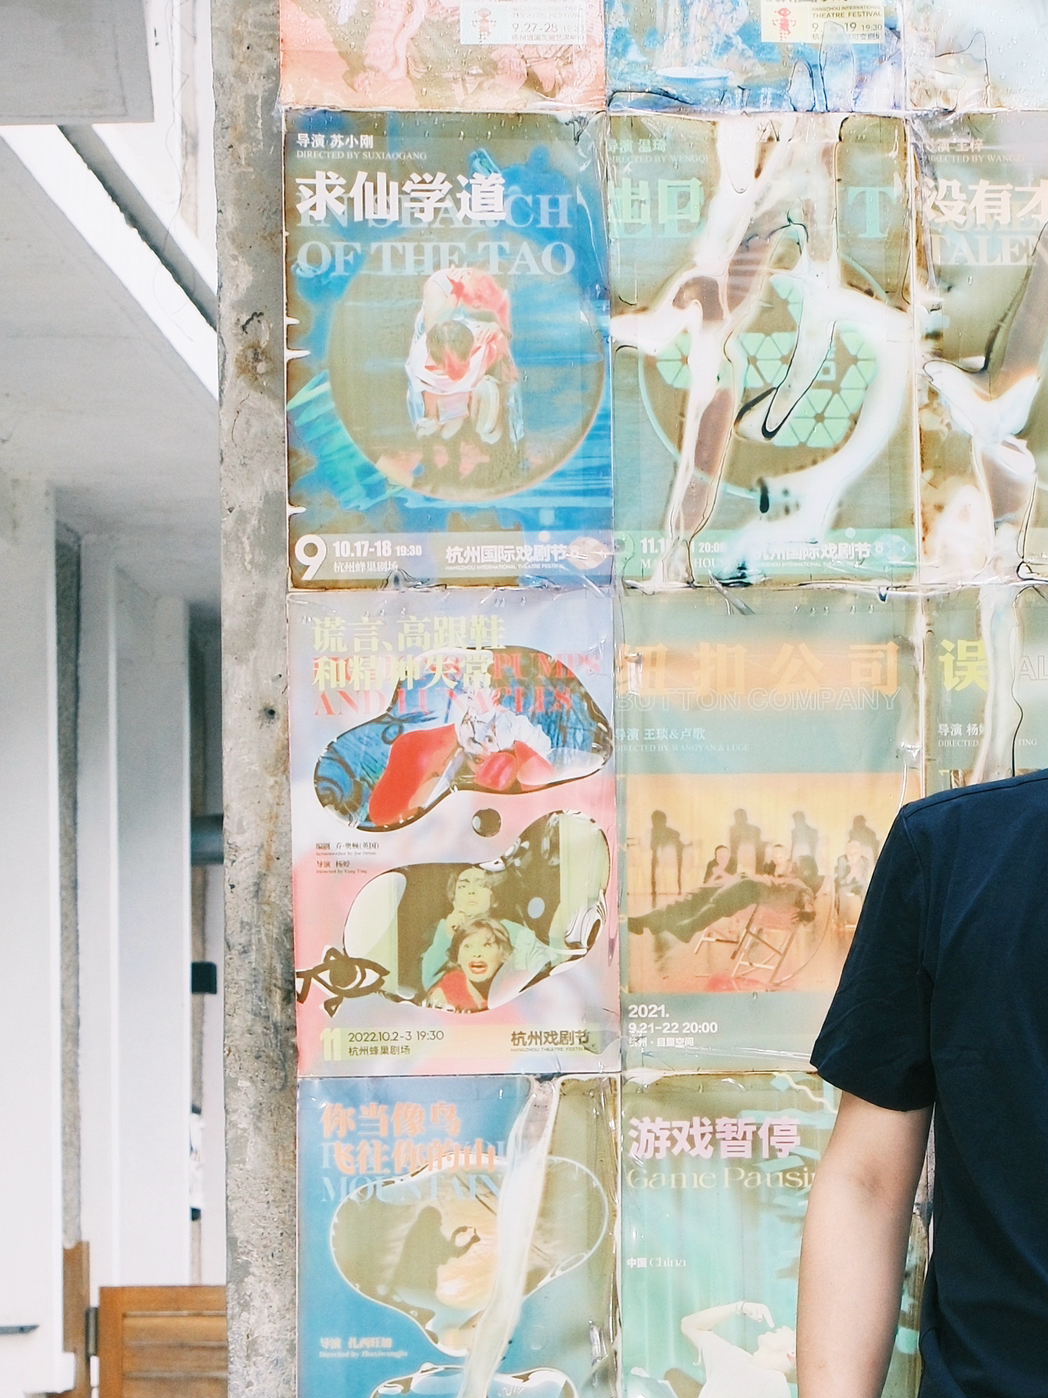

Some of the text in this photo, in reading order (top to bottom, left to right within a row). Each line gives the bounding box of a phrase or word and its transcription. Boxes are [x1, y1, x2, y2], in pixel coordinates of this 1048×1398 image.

[296, 133, 374, 149] 导演 苏小刚
[296, 151, 345, 160] DIRECTED
[346, 151, 360, 160] BY
[295, 170, 507, 222] 求仙学道
[297, 241, 362, 276] OF
[478, 241, 576, 276] TAO
[295, 534, 327, 580] 9
[333, 540, 422, 557] 10.17-18 19:30
[445, 544, 567, 563] 杭州国际戏剧节
[312, 615, 506, 651] 谎言、高跟鞋
[312, 654, 494, 691] 和精神失常
[748, 687, 902, 710] COMPANY
[938, 723, 962, 736] 导演
[629, 1004, 669, 1017] 2021.
[348, 1030, 444, 1042] 2022.10.2-3 19:30
[628, 1022, 718, 1033] 9.21-22 20:00
[320, 1027, 341, 1061] 11
[511, 1030, 589, 1046] 杭州戏剧节
[348, 1045, 410, 1056] 杭州蜂巢剧场
[320, 1102, 461, 1138] 你当像鸟
[628, 1117, 801, 1159] 游戏暂停
[626, 1168, 718, 1189] Game
[626, 1256, 687, 1268] 中国 China
